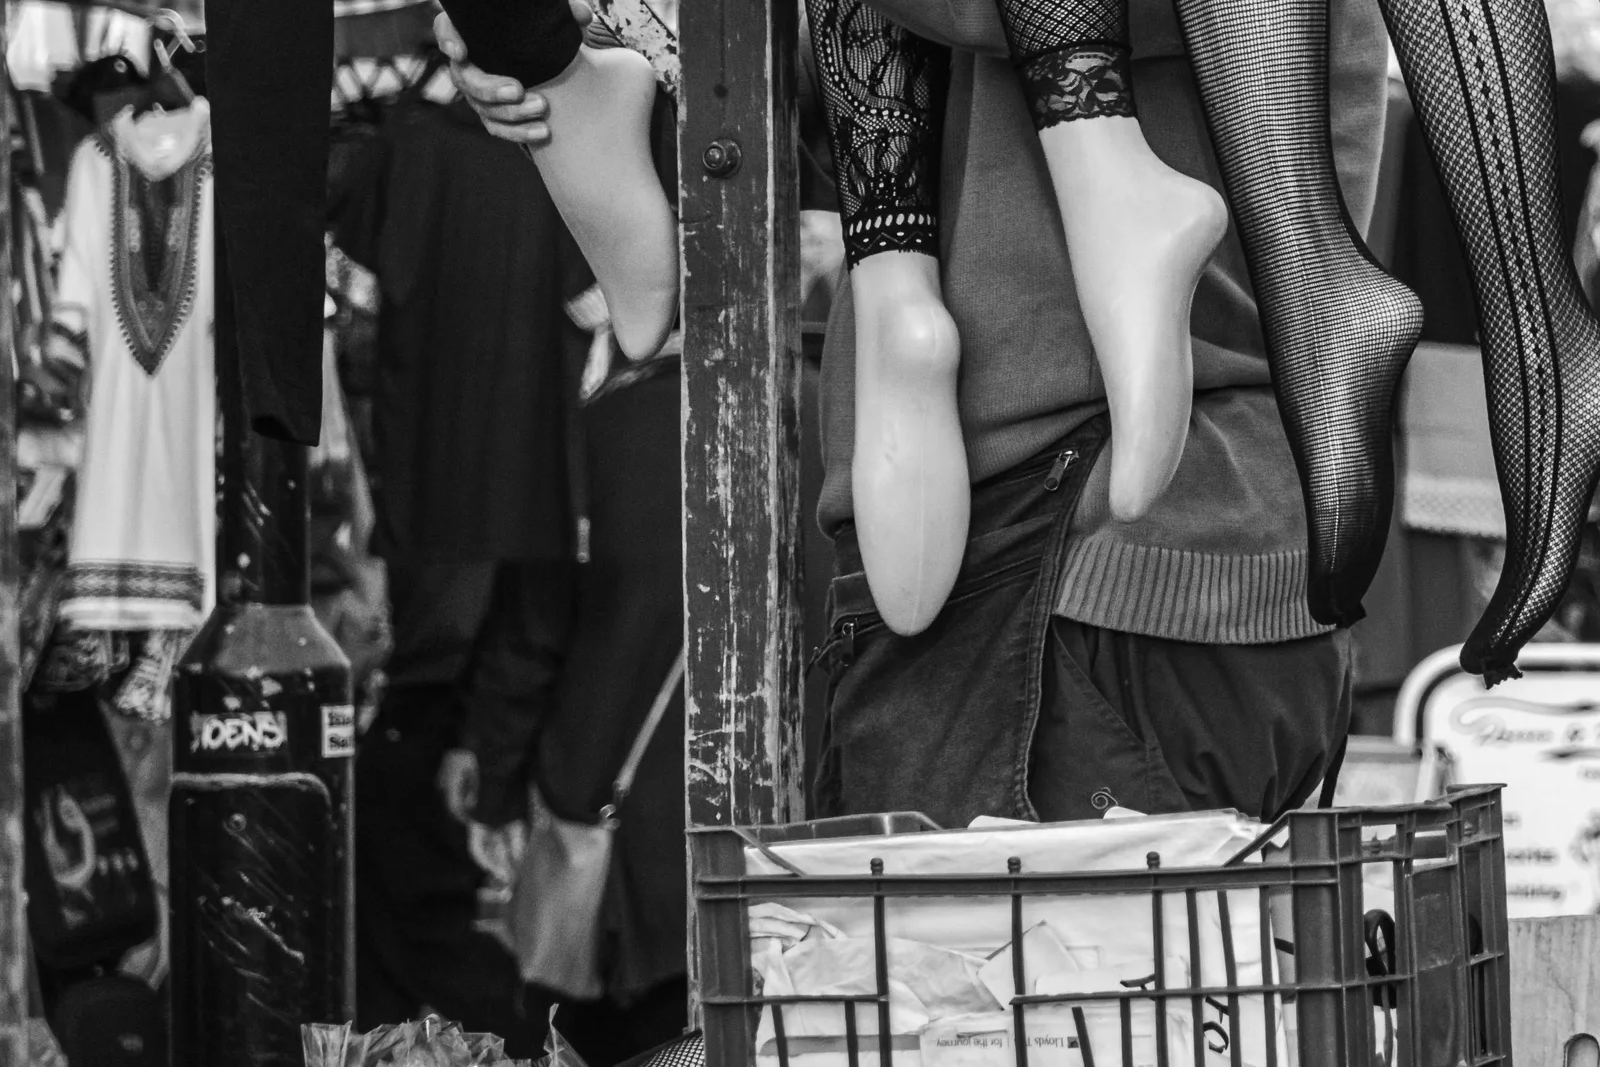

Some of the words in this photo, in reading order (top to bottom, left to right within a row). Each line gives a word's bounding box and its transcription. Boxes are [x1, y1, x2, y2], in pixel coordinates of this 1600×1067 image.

[936, 1035, 971, 1048] journey
[972, 1037, 989, 1048] the
[990, 1037, 1003, 1048] for
[1033, 1035, 1064, 1049] Lloyds
